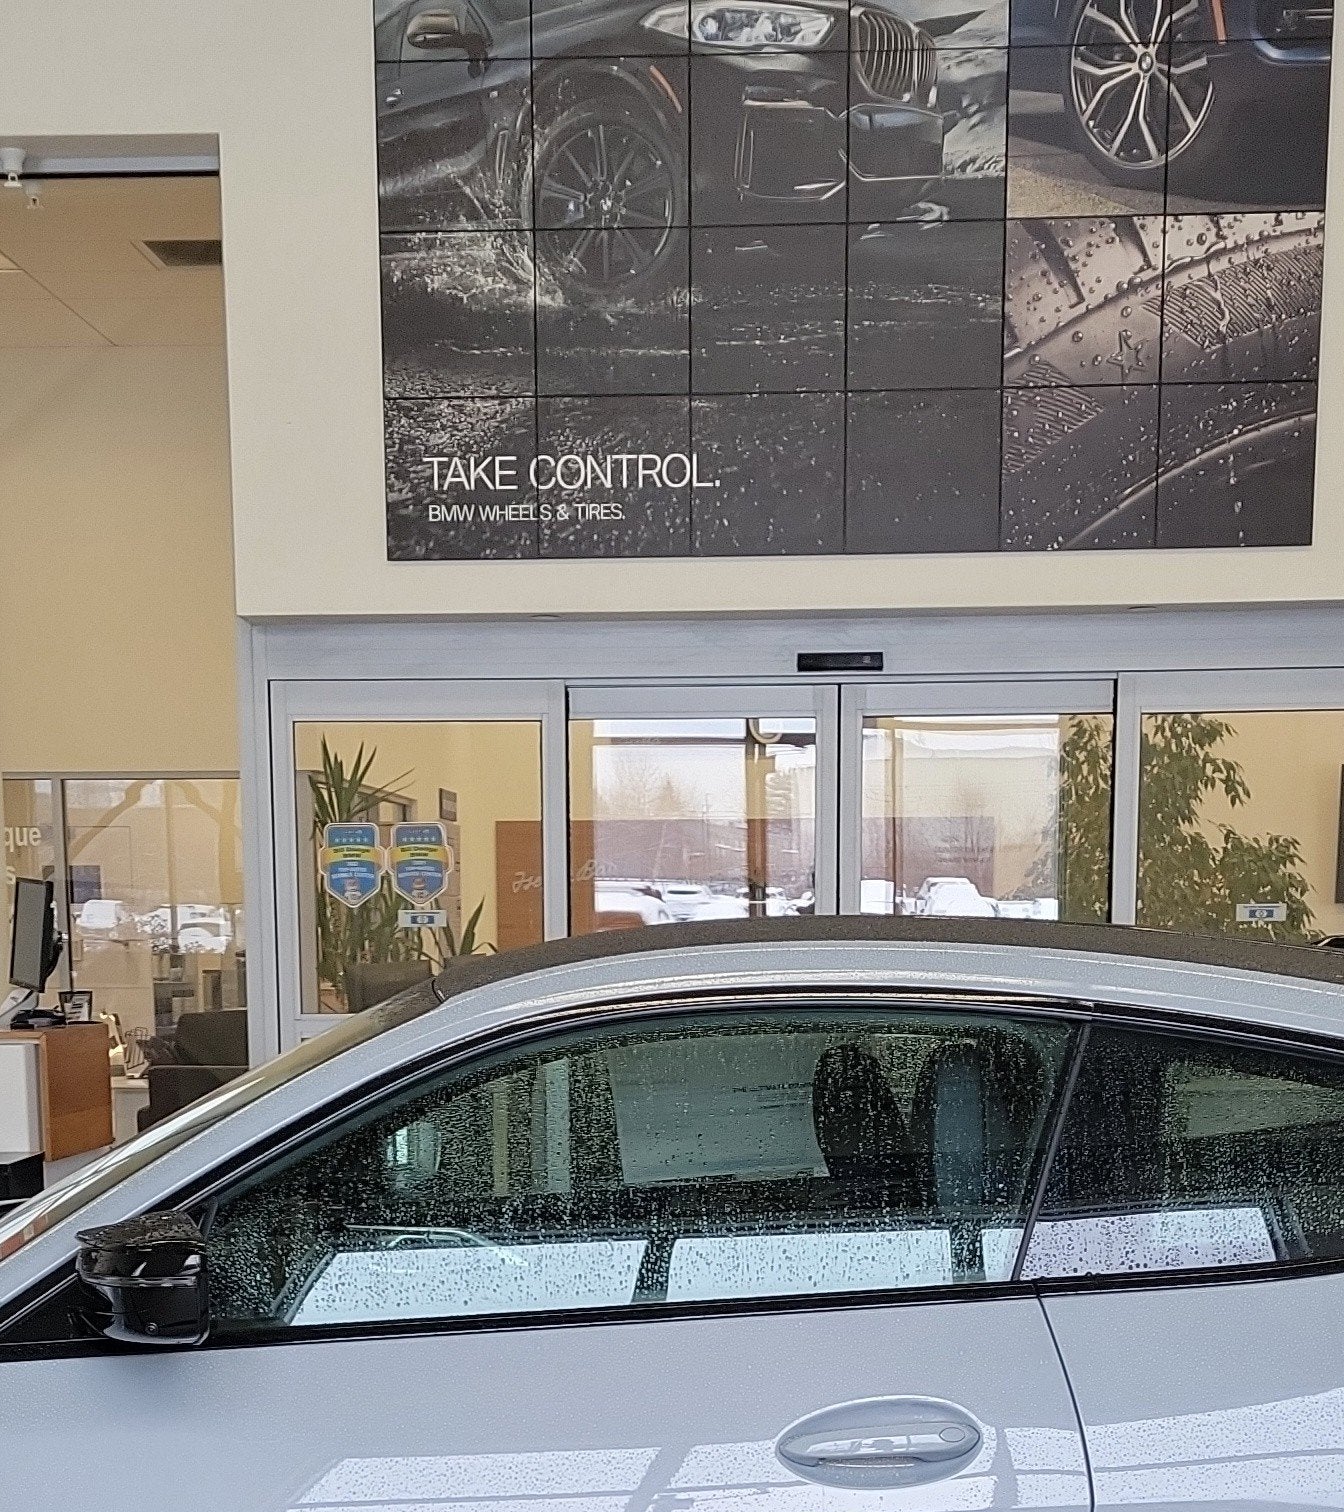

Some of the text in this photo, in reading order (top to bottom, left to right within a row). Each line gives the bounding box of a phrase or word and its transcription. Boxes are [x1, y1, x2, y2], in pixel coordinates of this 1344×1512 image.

[422, 452, 722, 492] TAKE CONTROL.
[428, 502, 626, 522] BMW WHEELS & TIRES.
